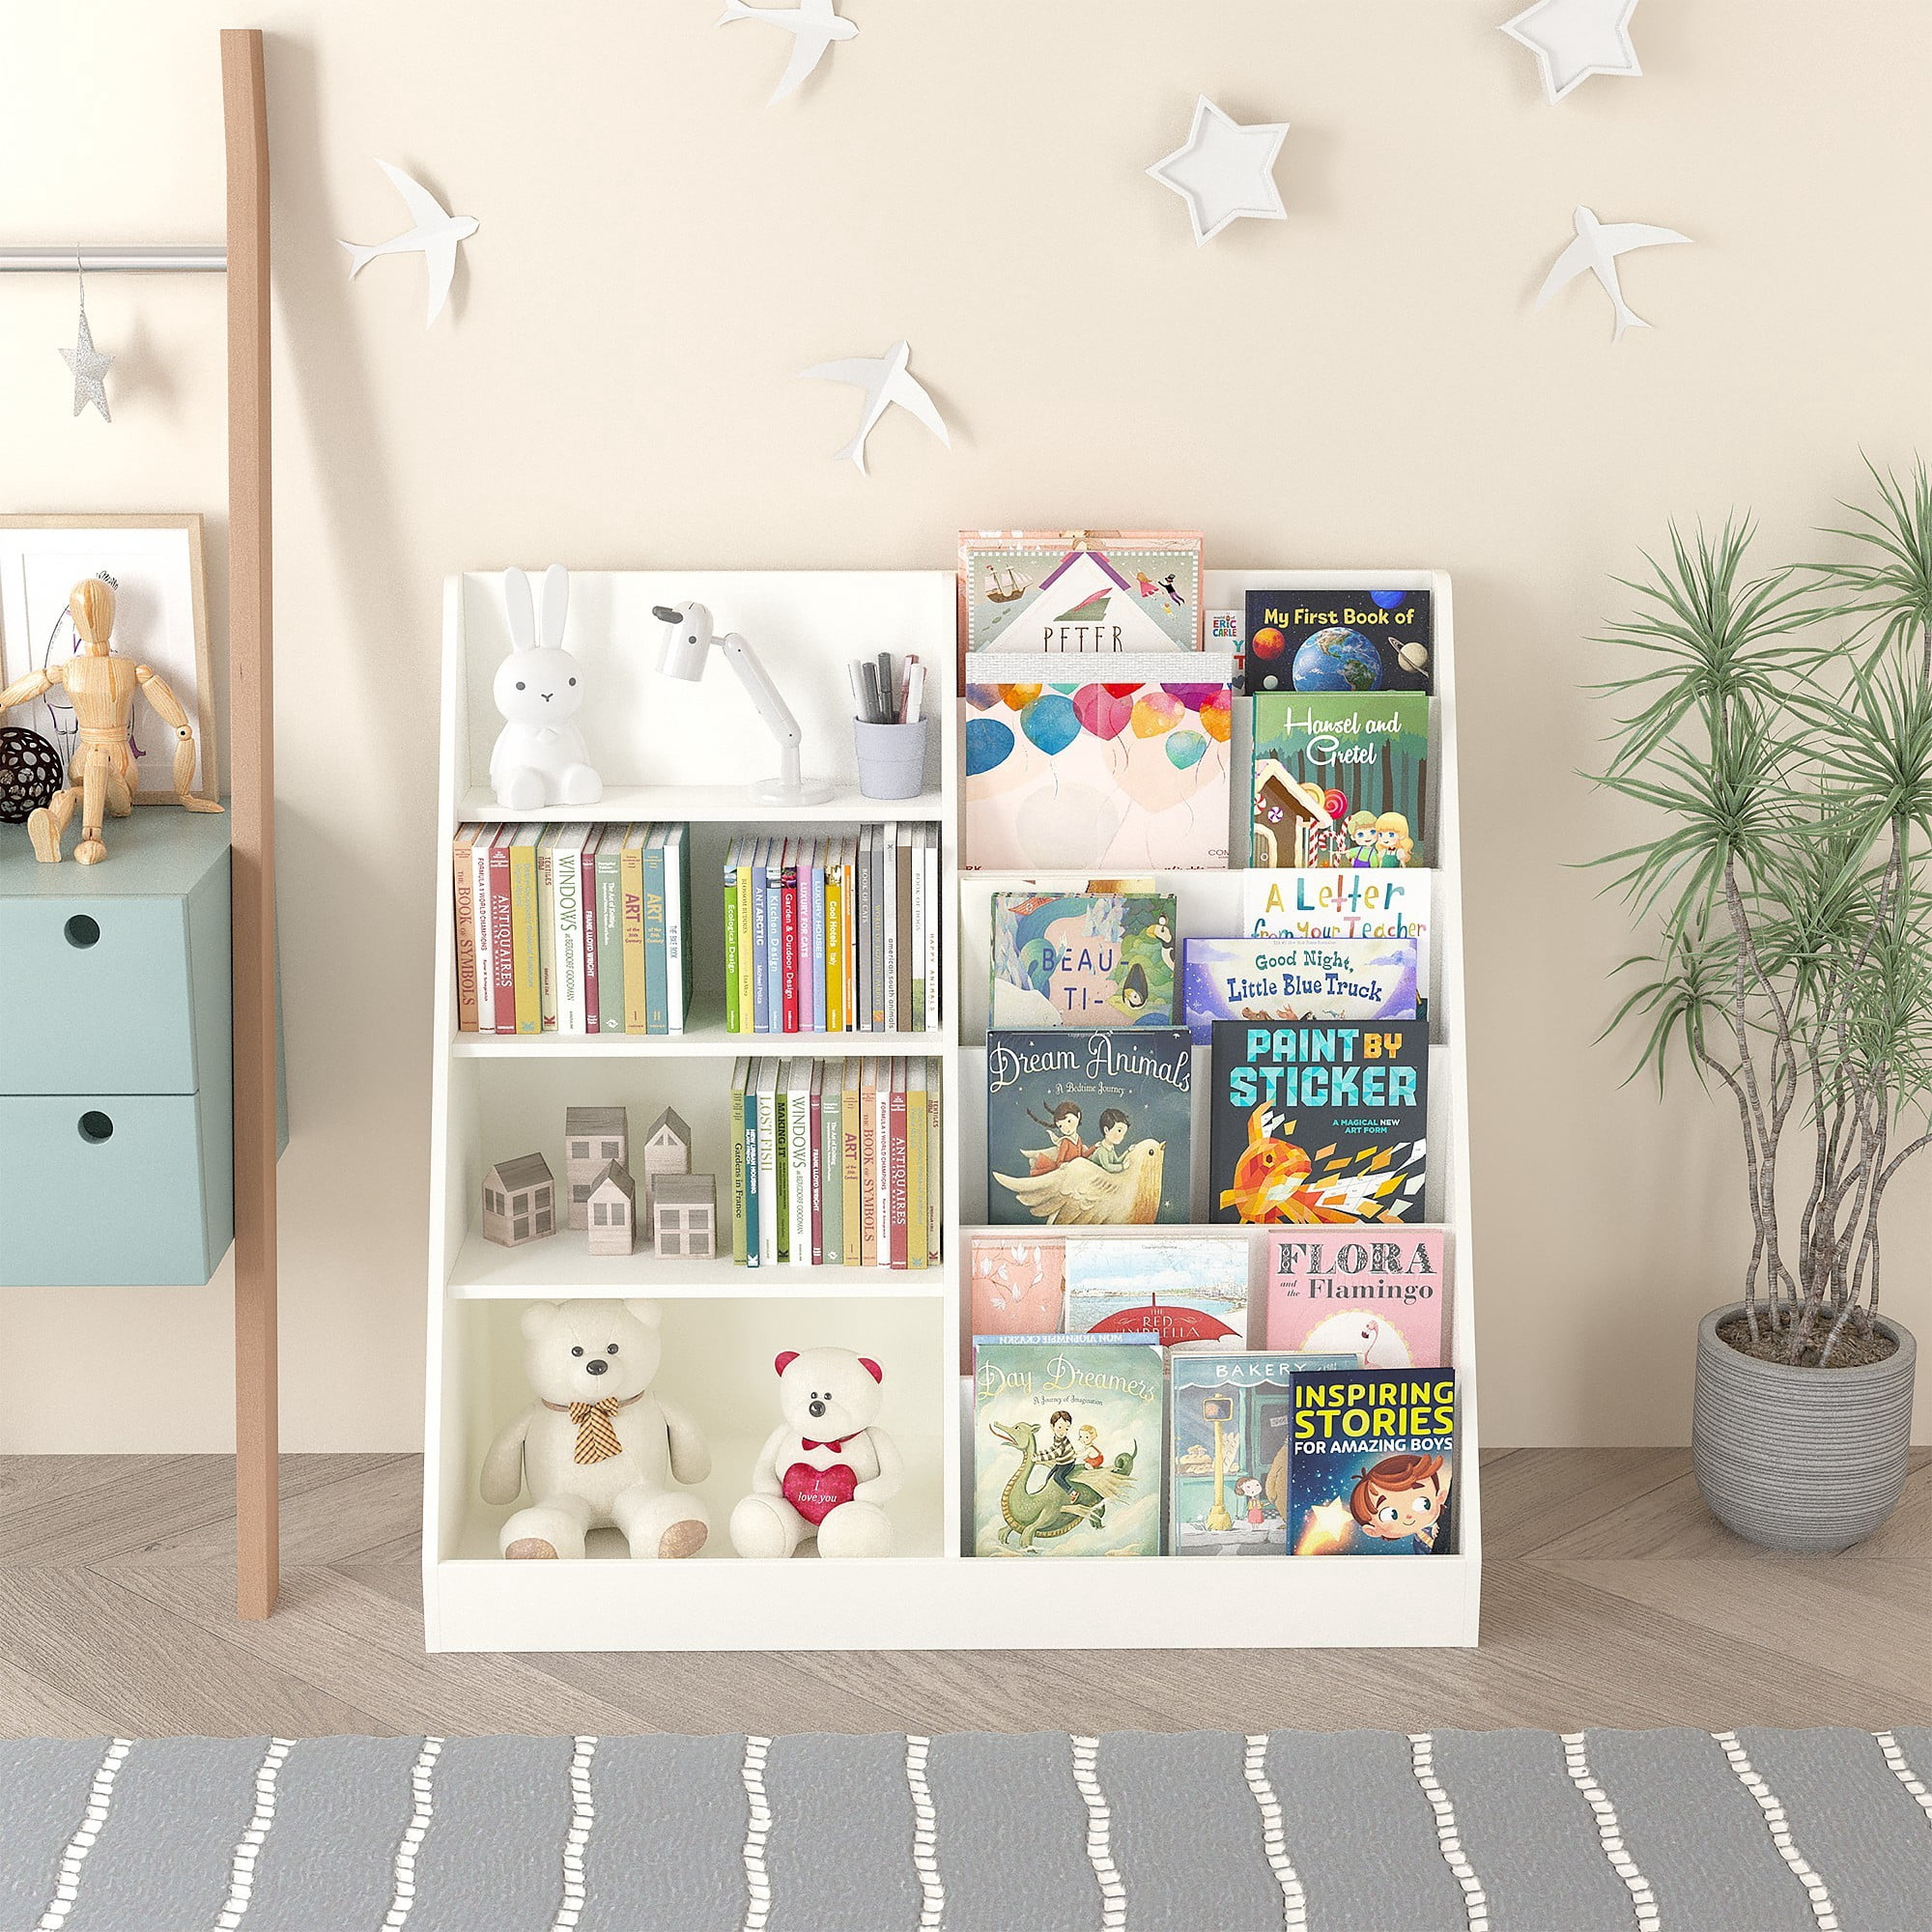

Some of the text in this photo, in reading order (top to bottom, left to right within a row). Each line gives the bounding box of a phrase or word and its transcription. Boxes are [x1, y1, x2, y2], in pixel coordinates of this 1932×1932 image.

[1264, 608, 1415, 628] My First Book of
[1284, 707, 1402, 735] Hansel and
[1306, 735, 1378, 767] Gretel
[477, 858, 486, 887] FORMULA
[458, 887, 472, 925] BOOK
[558, 855, 577, 931] WINDOWS
[862, 892, 868, 902] OF
[1265, 874, 1405, 913] A Letter
[625, 894, 640, 923] ART
[647, 893, 663, 923] ART
[755, 887, 764, 946] ANTARCTIC
[784, 893, 793, 923] Garden
[727, 904, 736, 974] Ecological Design
[769, 895, 780, 972] Kitchen Design
[875, 933, 881, 943] OF
[1344, 912, 1427, 938] Teacher
[497, 895, 512, 987] ANTIQUAIRES
[669, 947, 678, 959] BOOK
[460, 939, 475, 1006] SYMBOLS
[828, 952, 838, 966] Italy
[1042, 948, 1128, 974] BEAU-
[1256, 951, 1354, 974] Good Night,
[784, 972, 794, 999] Design
[1064, 987, 1103, 1010] TI-
[1227, 973, 1382, 1002] Little Blue Truck
[1247, 1029, 1403, 1063] PAINT BY
[989, 1030, 1191, 1093] Dream Animals
[1065, 1082, 1096, 1093] Bedtime
[1097, 1081, 1125, 1097] Journey
[1230, 1066, 1417, 1107] STICKER
[759, 1096, 773, 1171] LOST FISH
[792, 1095, 807, 1169] WINDOWS
[844, 1133, 857, 1160] ART
[734, 1143, 743, 1178] Gardens
[779, 1147, 786, 1157] IT
[736, 1179, 743, 1188] in
[864, 1129, 874, 1242] BOOK SYMBOLS
[895, 1137, 906, 1225] ANTIQUAIRES
[1276, 1242, 1437, 1276] FLORA
[1280, 1279, 1297, 1289] and
[1286, 1278, 1434, 1305] the Flamingo
[1143, 1316, 1173, 1327] RED
[978, 1352, 1155, 1402] Day Dreamers
[1216, 1363, 1307, 1378] BAKERY
[1041, 1395, 1062, 1406] Journey
[1295, 1381, 1453, 1408] INSPIRING
[1294, 1406, 1453, 1439] STORIES
[1294, 1436, 1453, 1455] FOR AMAZING BOYS
[798, 1492, 838, 1505] love you
[814, 1480, 819, 1492] I
